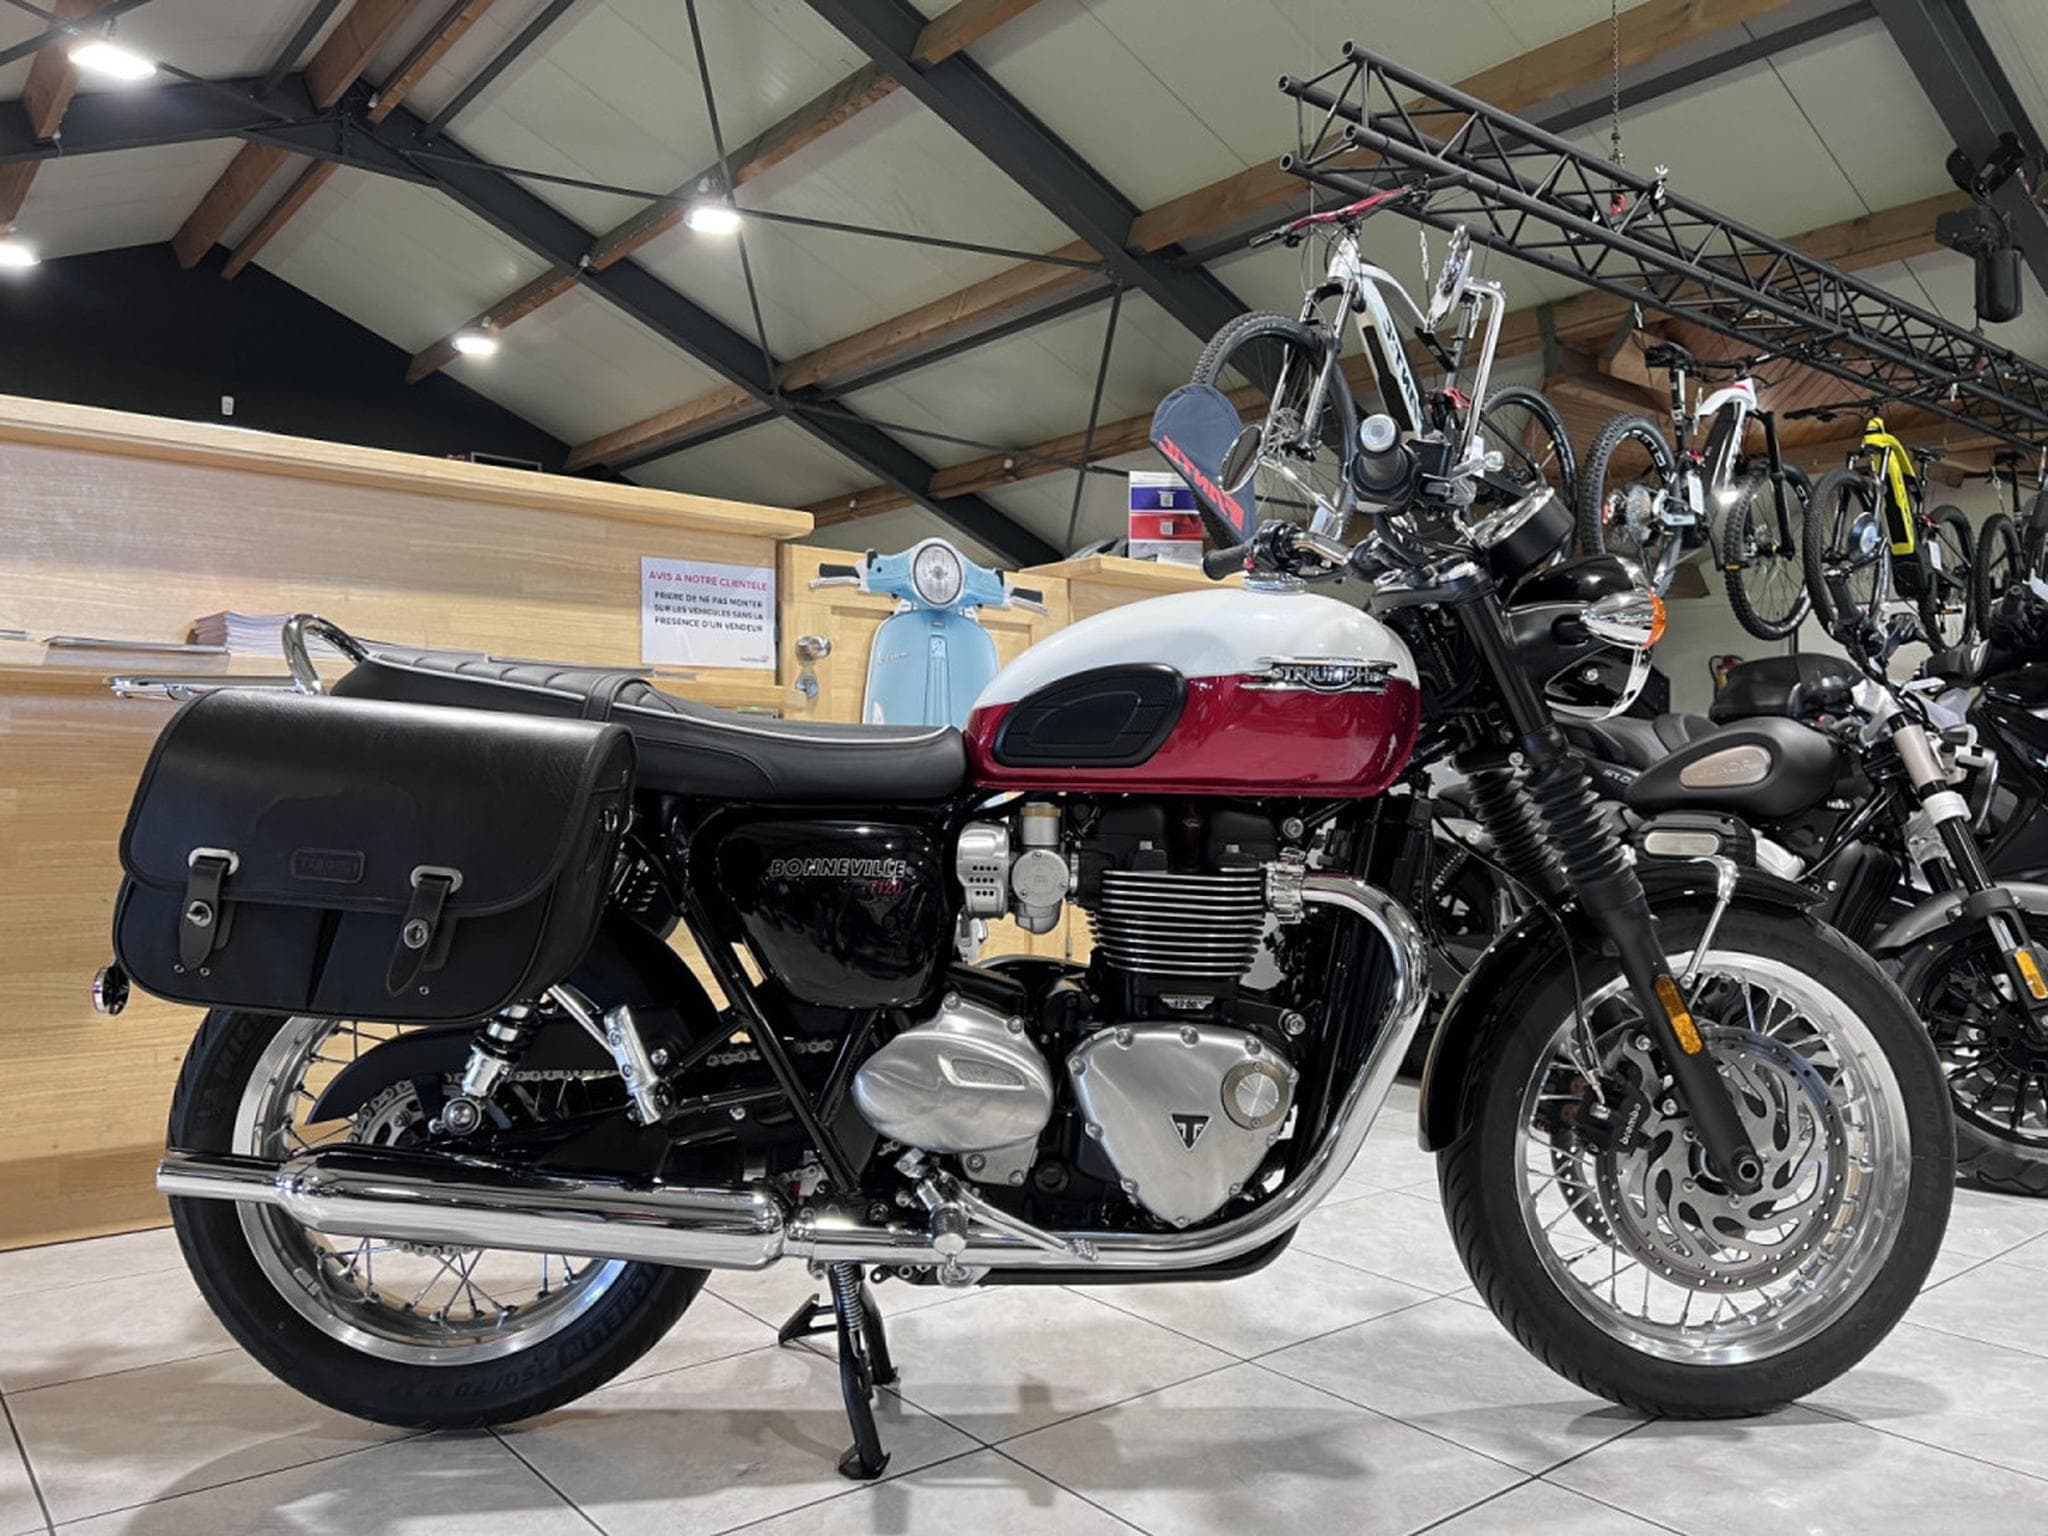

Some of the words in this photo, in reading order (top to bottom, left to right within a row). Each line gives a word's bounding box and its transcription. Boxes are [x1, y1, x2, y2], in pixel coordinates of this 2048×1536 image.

[649, 571, 673, 582] AVIS
[684, 574, 717, 586] NOTRE
[720, 578, 768, 591] CLIENTELE
[685, 594, 697, 603] DE
[699, 595, 710, 604] NE
[712, 596, 728, 605] PAS
[729, 598, 763, 608] MONTER
[654, 604, 671, 612] SUR
[672, 605, 687, 614] LES
[688, 607, 731, 617] VEHICULES
[732, 610, 752, 619] SANS
[753, 612, 763, 620] LA
[654, 616, 699, 627] PRESENCE
[724, 622, 763, 632] VENDEUR
[1280, 666, 1369, 684] TRIUMPH
[770, 858, 907, 878] BONNEVILLE
[1619, 1103, 1641, 1145] brembo
